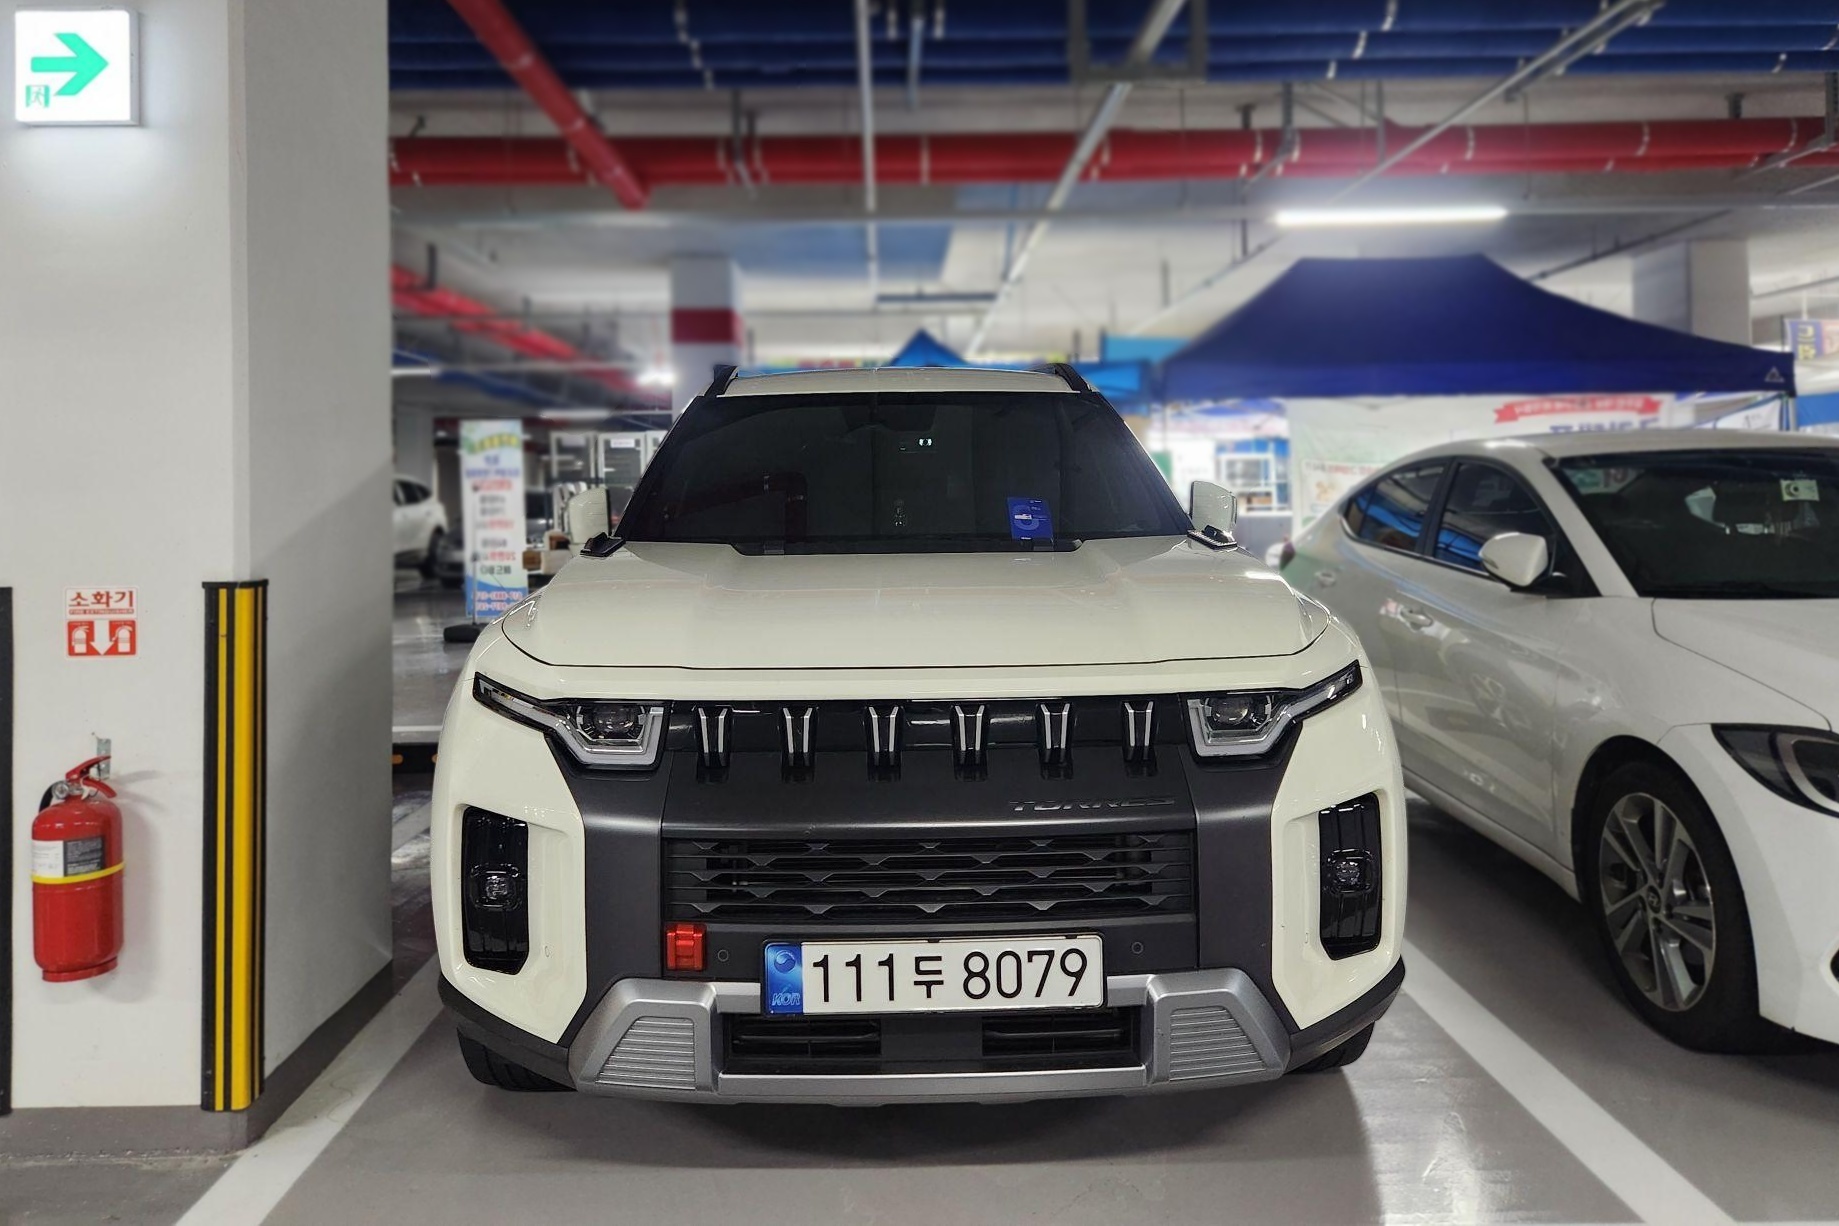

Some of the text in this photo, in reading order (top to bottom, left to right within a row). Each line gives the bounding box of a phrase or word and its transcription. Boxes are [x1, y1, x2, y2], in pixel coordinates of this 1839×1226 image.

[68, 590, 134, 608] 소화기
[963, 948, 1088, 1000] 8079
[771, 992, 801, 1006] KOR
